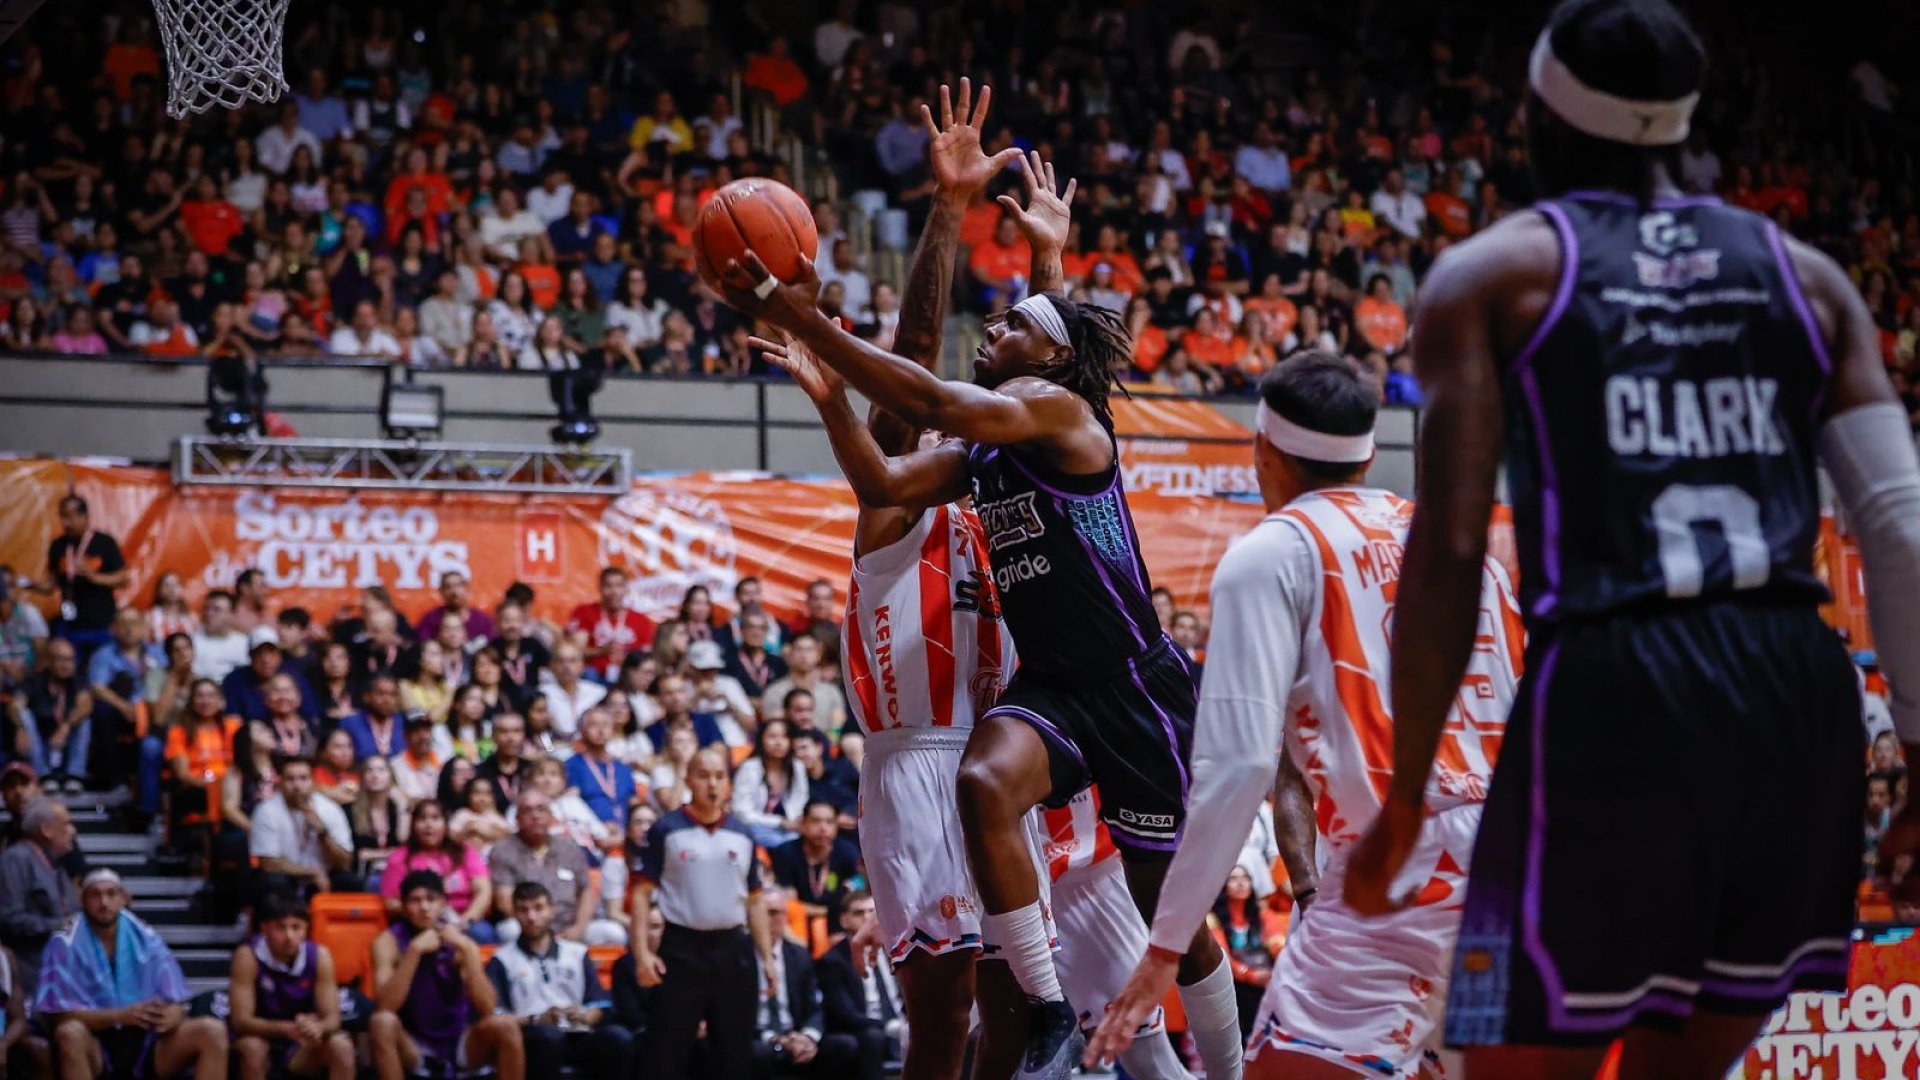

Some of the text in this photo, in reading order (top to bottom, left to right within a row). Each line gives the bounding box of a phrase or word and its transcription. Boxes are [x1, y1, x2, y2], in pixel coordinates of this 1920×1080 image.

[1604, 375, 1786, 458] CLARK
[234, 490, 439, 545] Sorteo
[257, 540, 471, 589] CETYS
[527, 529, 555, 562] H
[1726, 1031, 1920, 1080] CETY
